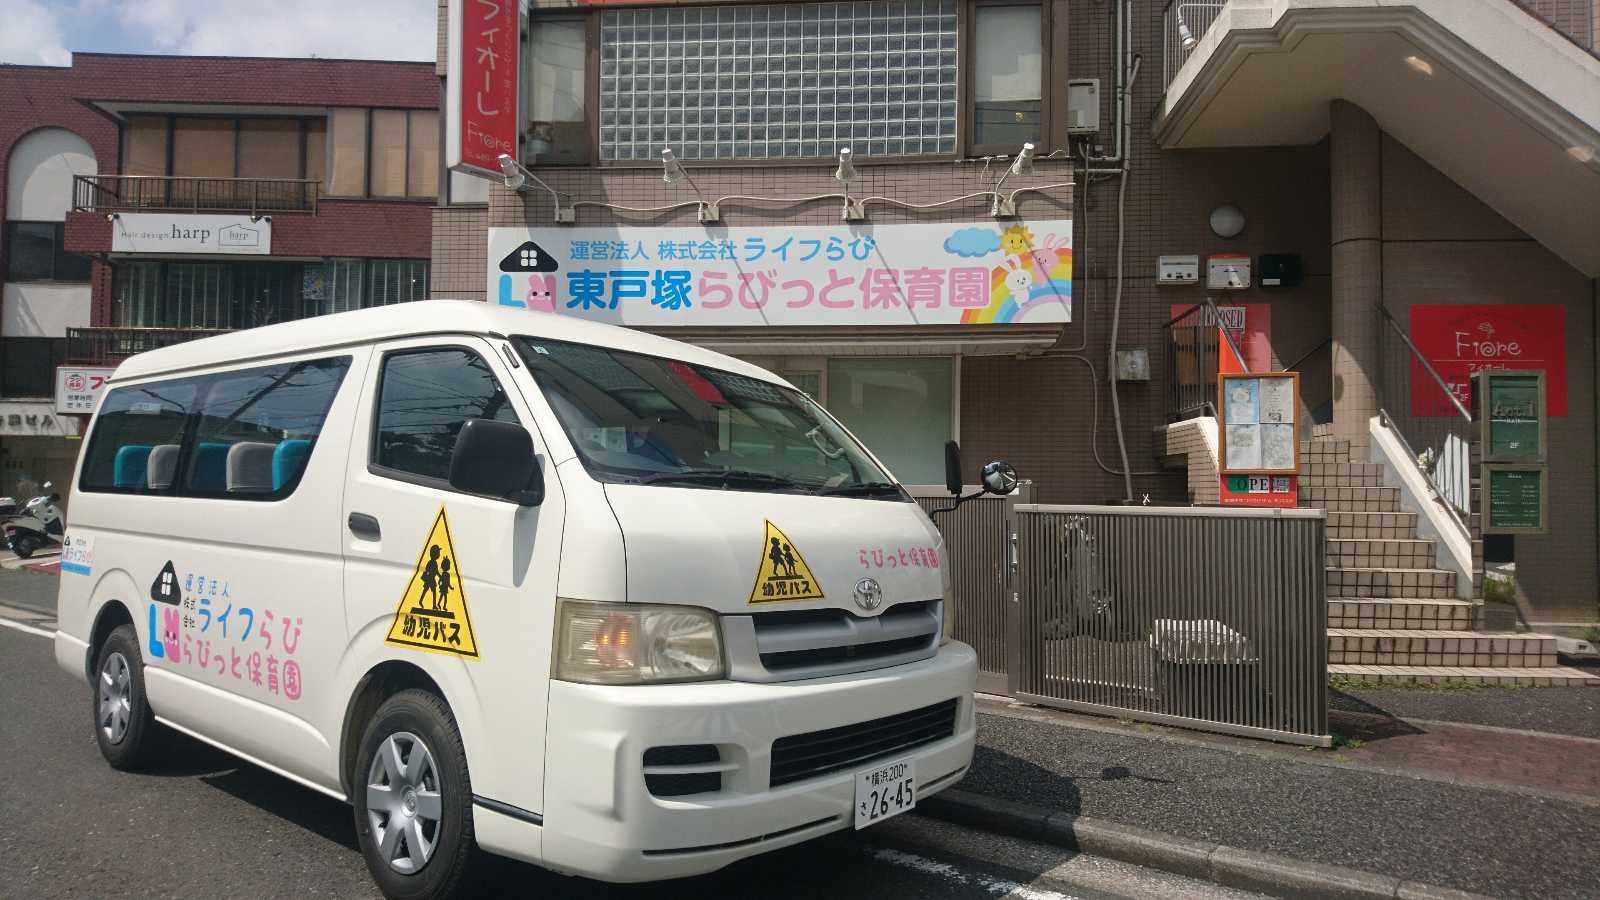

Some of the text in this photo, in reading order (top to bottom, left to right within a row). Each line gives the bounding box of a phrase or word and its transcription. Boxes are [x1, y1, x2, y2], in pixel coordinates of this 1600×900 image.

[171, 224, 210, 243] harp
[229, 231, 249, 241] harp
[570, 236, 877, 263] 運営法人 株式会社 ライフらび
[566, 267, 991, 310] 東戸塚らびっと保育園
[1455, 331, 1522, 357] Fiore
[1236, 478, 1275, 491] OPE
[858, 548, 939, 569] らびっと保育園
[762, 580, 812, 597] 幼児バス
[198, 598, 303, 655] ライフらび
[402, 613, 462, 647] 幼児バス
[183, 633, 302, 701] らびっと保育園
[870, 777, 914, 820] 26-45
